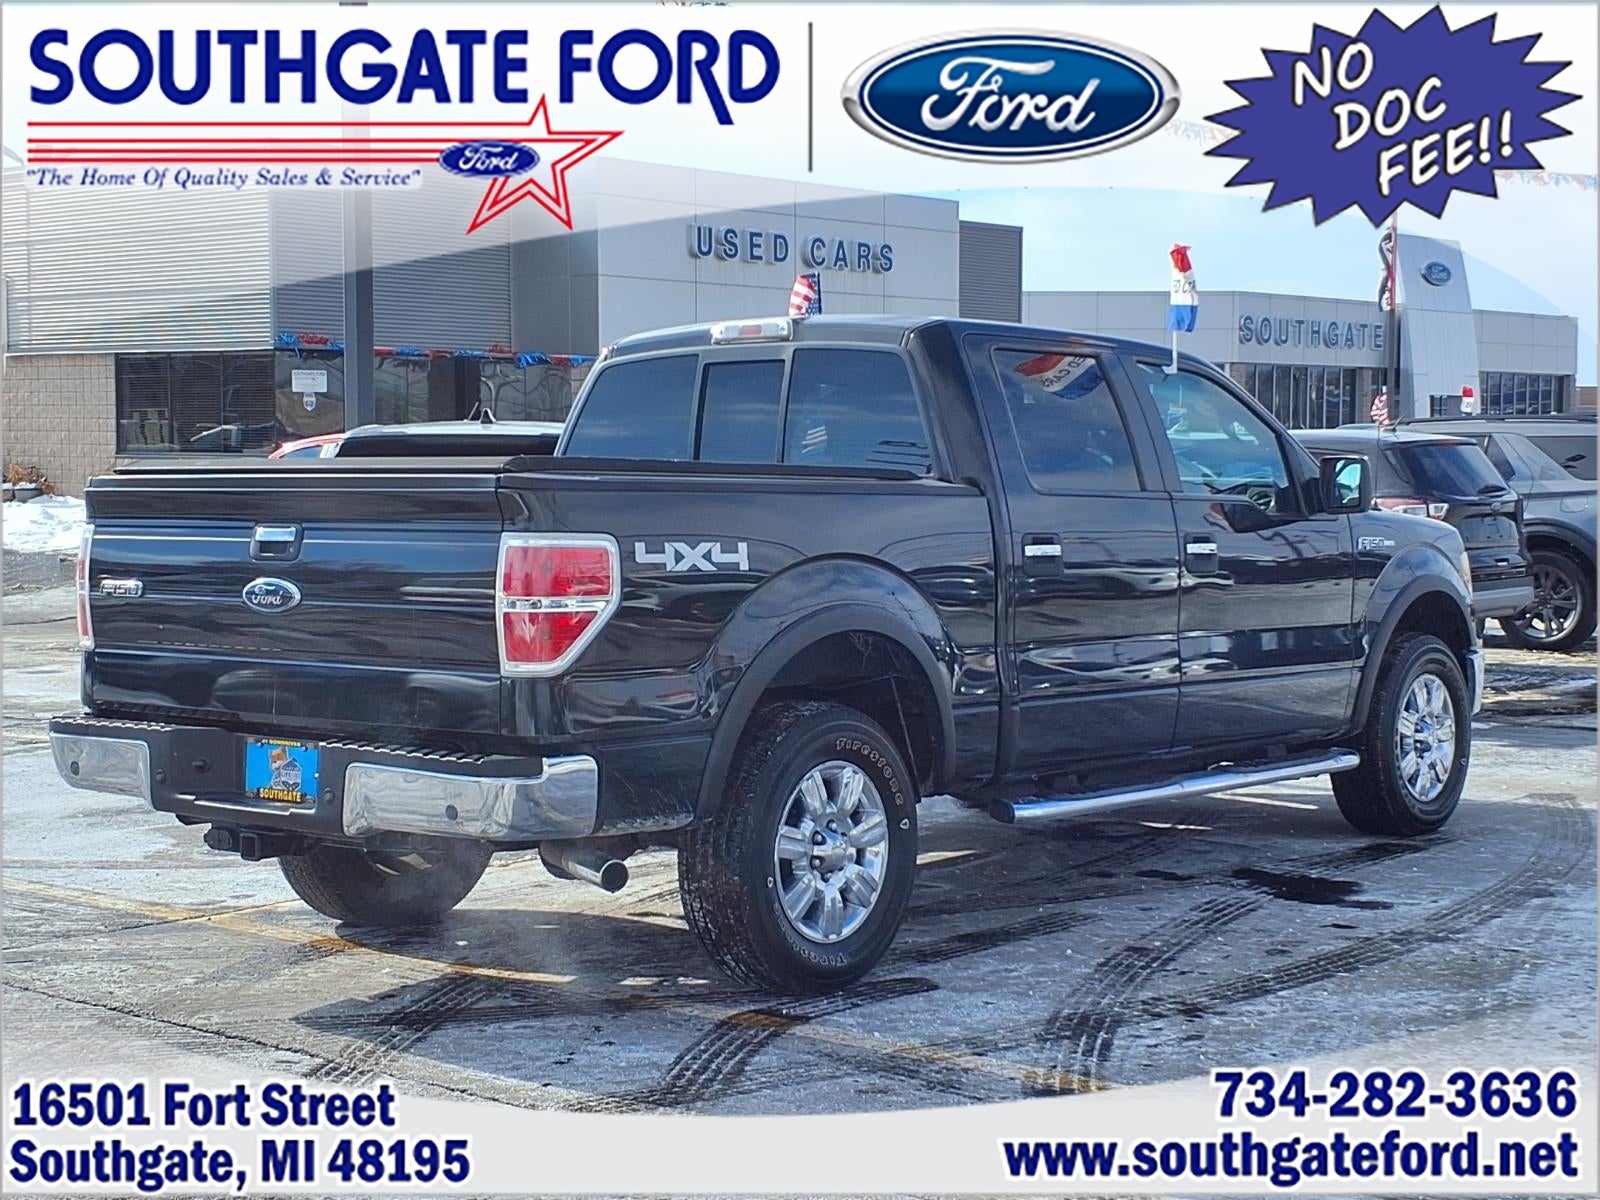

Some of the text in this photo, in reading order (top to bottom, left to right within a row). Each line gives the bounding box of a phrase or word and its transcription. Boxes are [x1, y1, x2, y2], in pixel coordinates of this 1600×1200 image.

[694, 224, 894, 273] USED CARS
[1240, 315, 1383, 349] SOUTHGATE
[251, 583, 284, 605] Ford
[259, 788, 302, 802] SOUTHGATE
